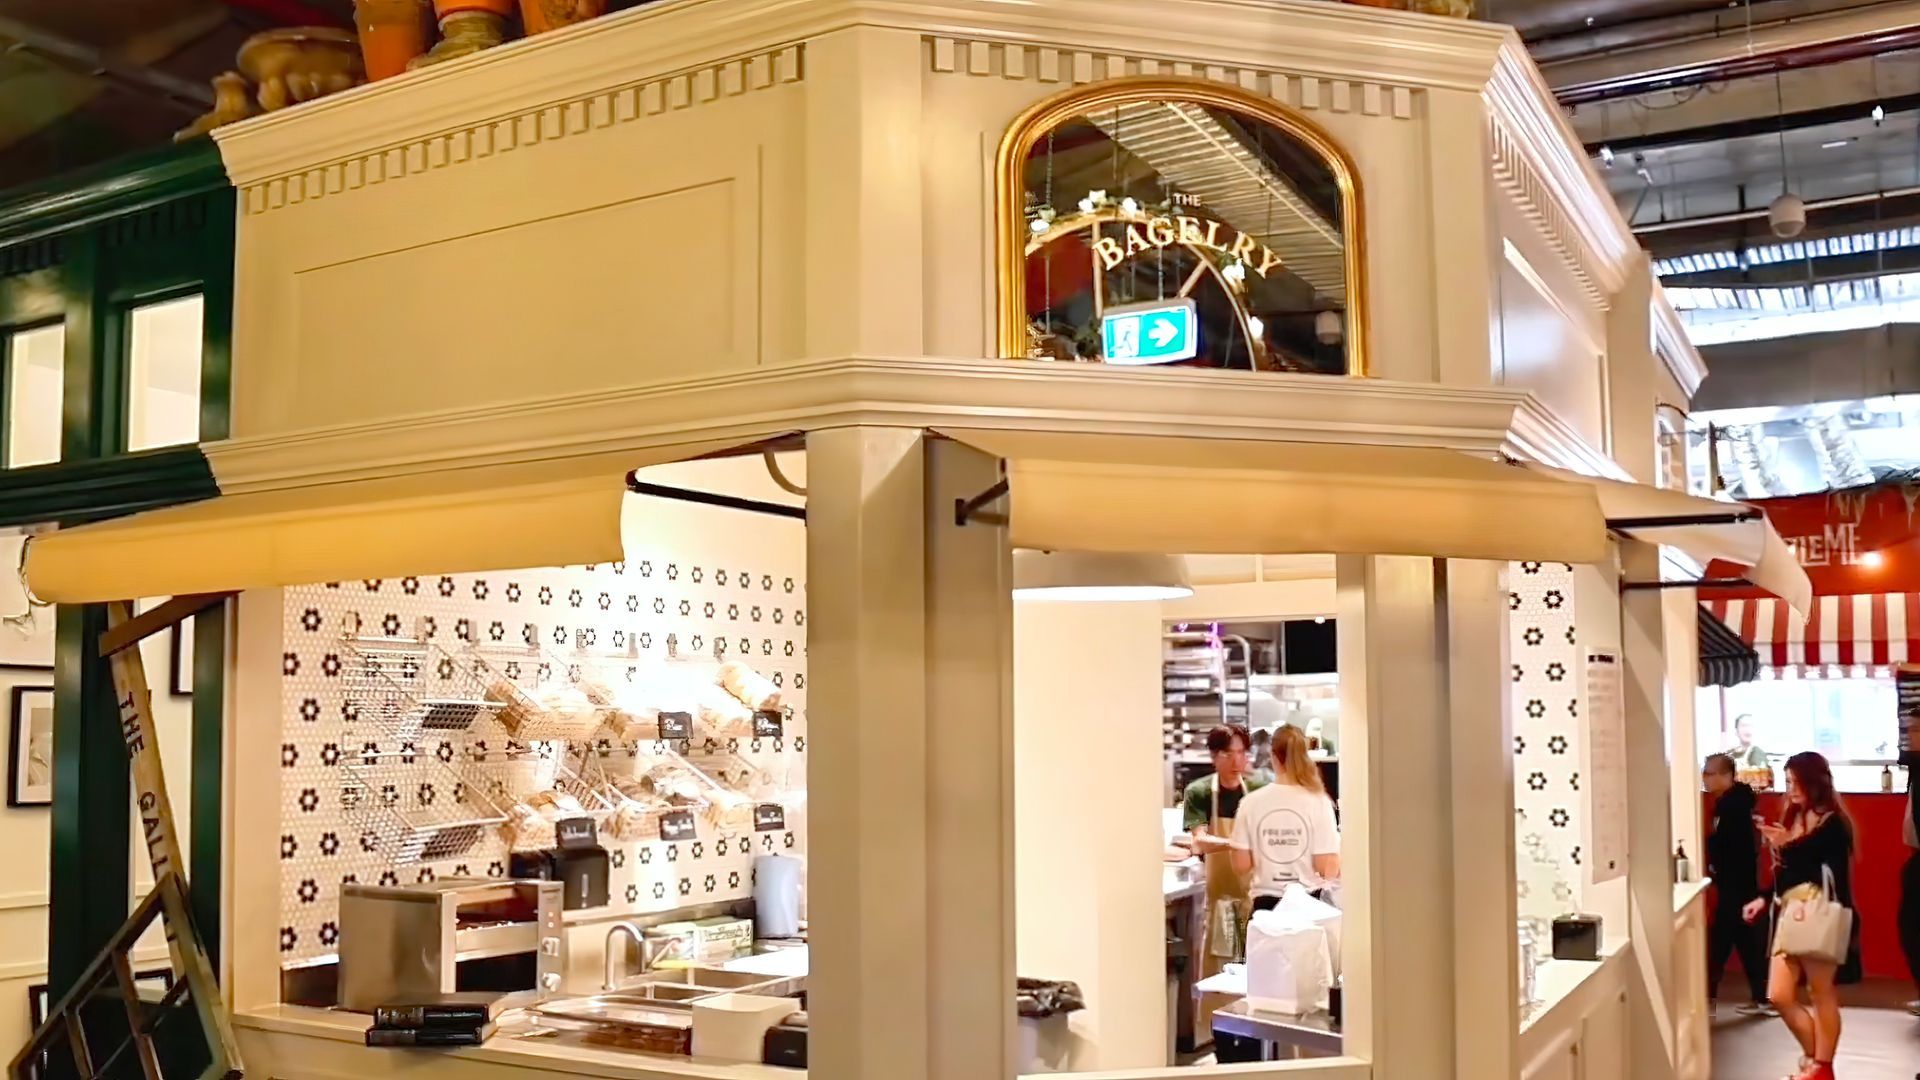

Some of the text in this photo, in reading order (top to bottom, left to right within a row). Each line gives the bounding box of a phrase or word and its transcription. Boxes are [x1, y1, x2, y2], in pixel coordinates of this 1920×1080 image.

[1172, 192, 1201, 207] THE
[1093, 215, 1284, 280] BAGELRY
[118, 691, 145, 760] THE
